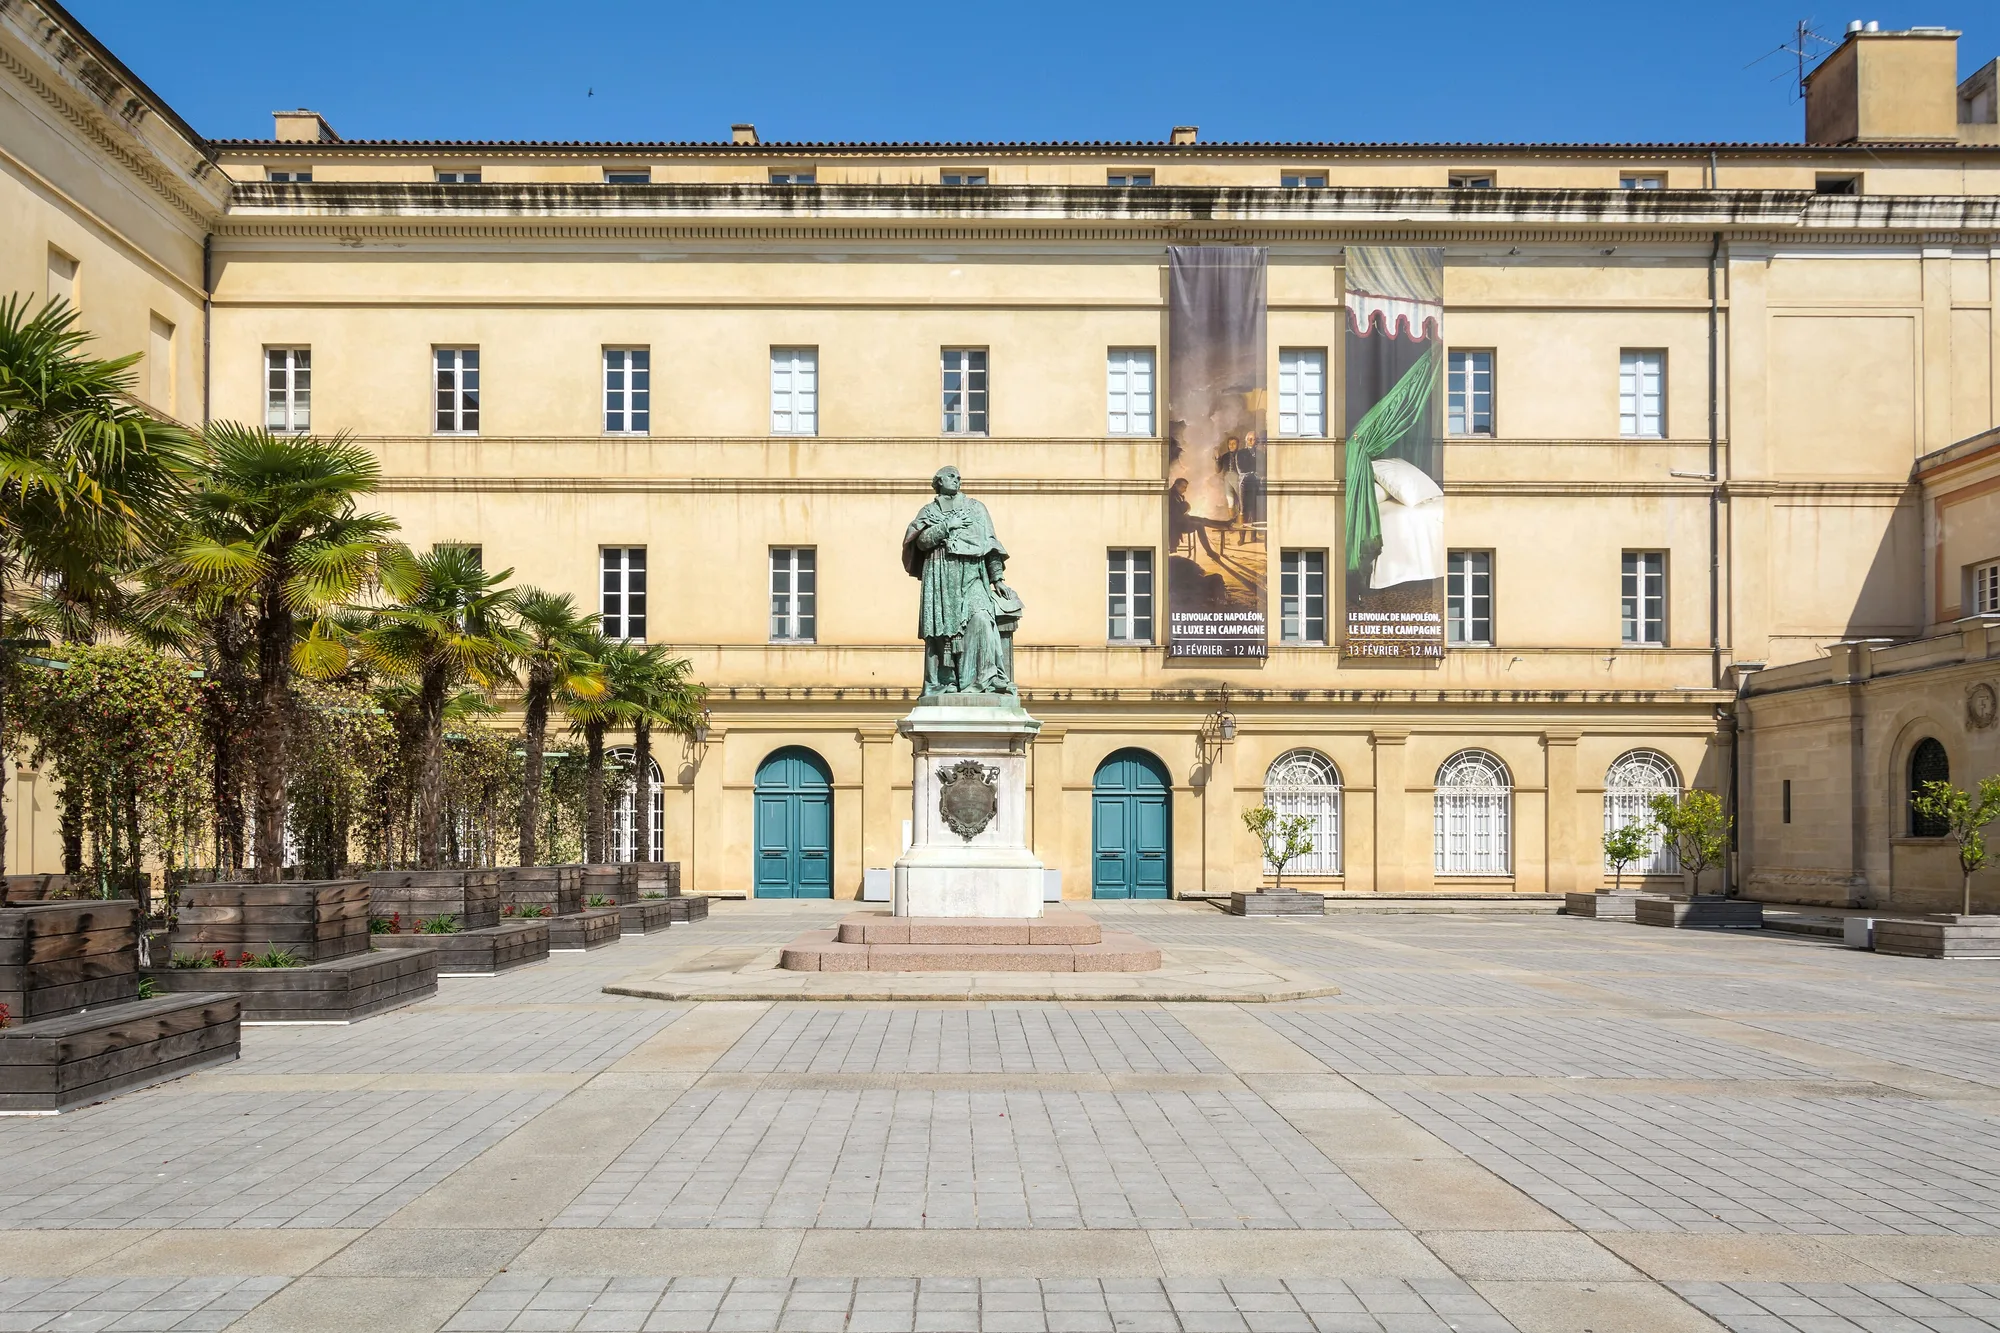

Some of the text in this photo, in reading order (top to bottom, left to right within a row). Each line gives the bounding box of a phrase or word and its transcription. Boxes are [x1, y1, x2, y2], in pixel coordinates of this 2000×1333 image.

[1172, 611, 1265, 622] LE BIVOUAC DE NAPOLÉON,
[1349, 611, 1441, 622] LE BIVOUAC DE NAPOLÉON,
[1172, 625, 1265, 634] LE LUXE EN CAMPAGNE
[1349, 625, 1441, 634] LE LUXE EN CAMPAGNE
[1172, 645, 1183, 655] 13
[1186, 643, 1223, 655] FÉVRIER
[1233, 645, 1244, 655] 12
[1247, 645, 1265, 655] MAI
[1349, 645, 1359, 655] 13
[1362, 643, 1399, 655] FÉVRIER
[1410, 645, 1421, 655] 12
[1424, 645, 1442, 655] MAI
